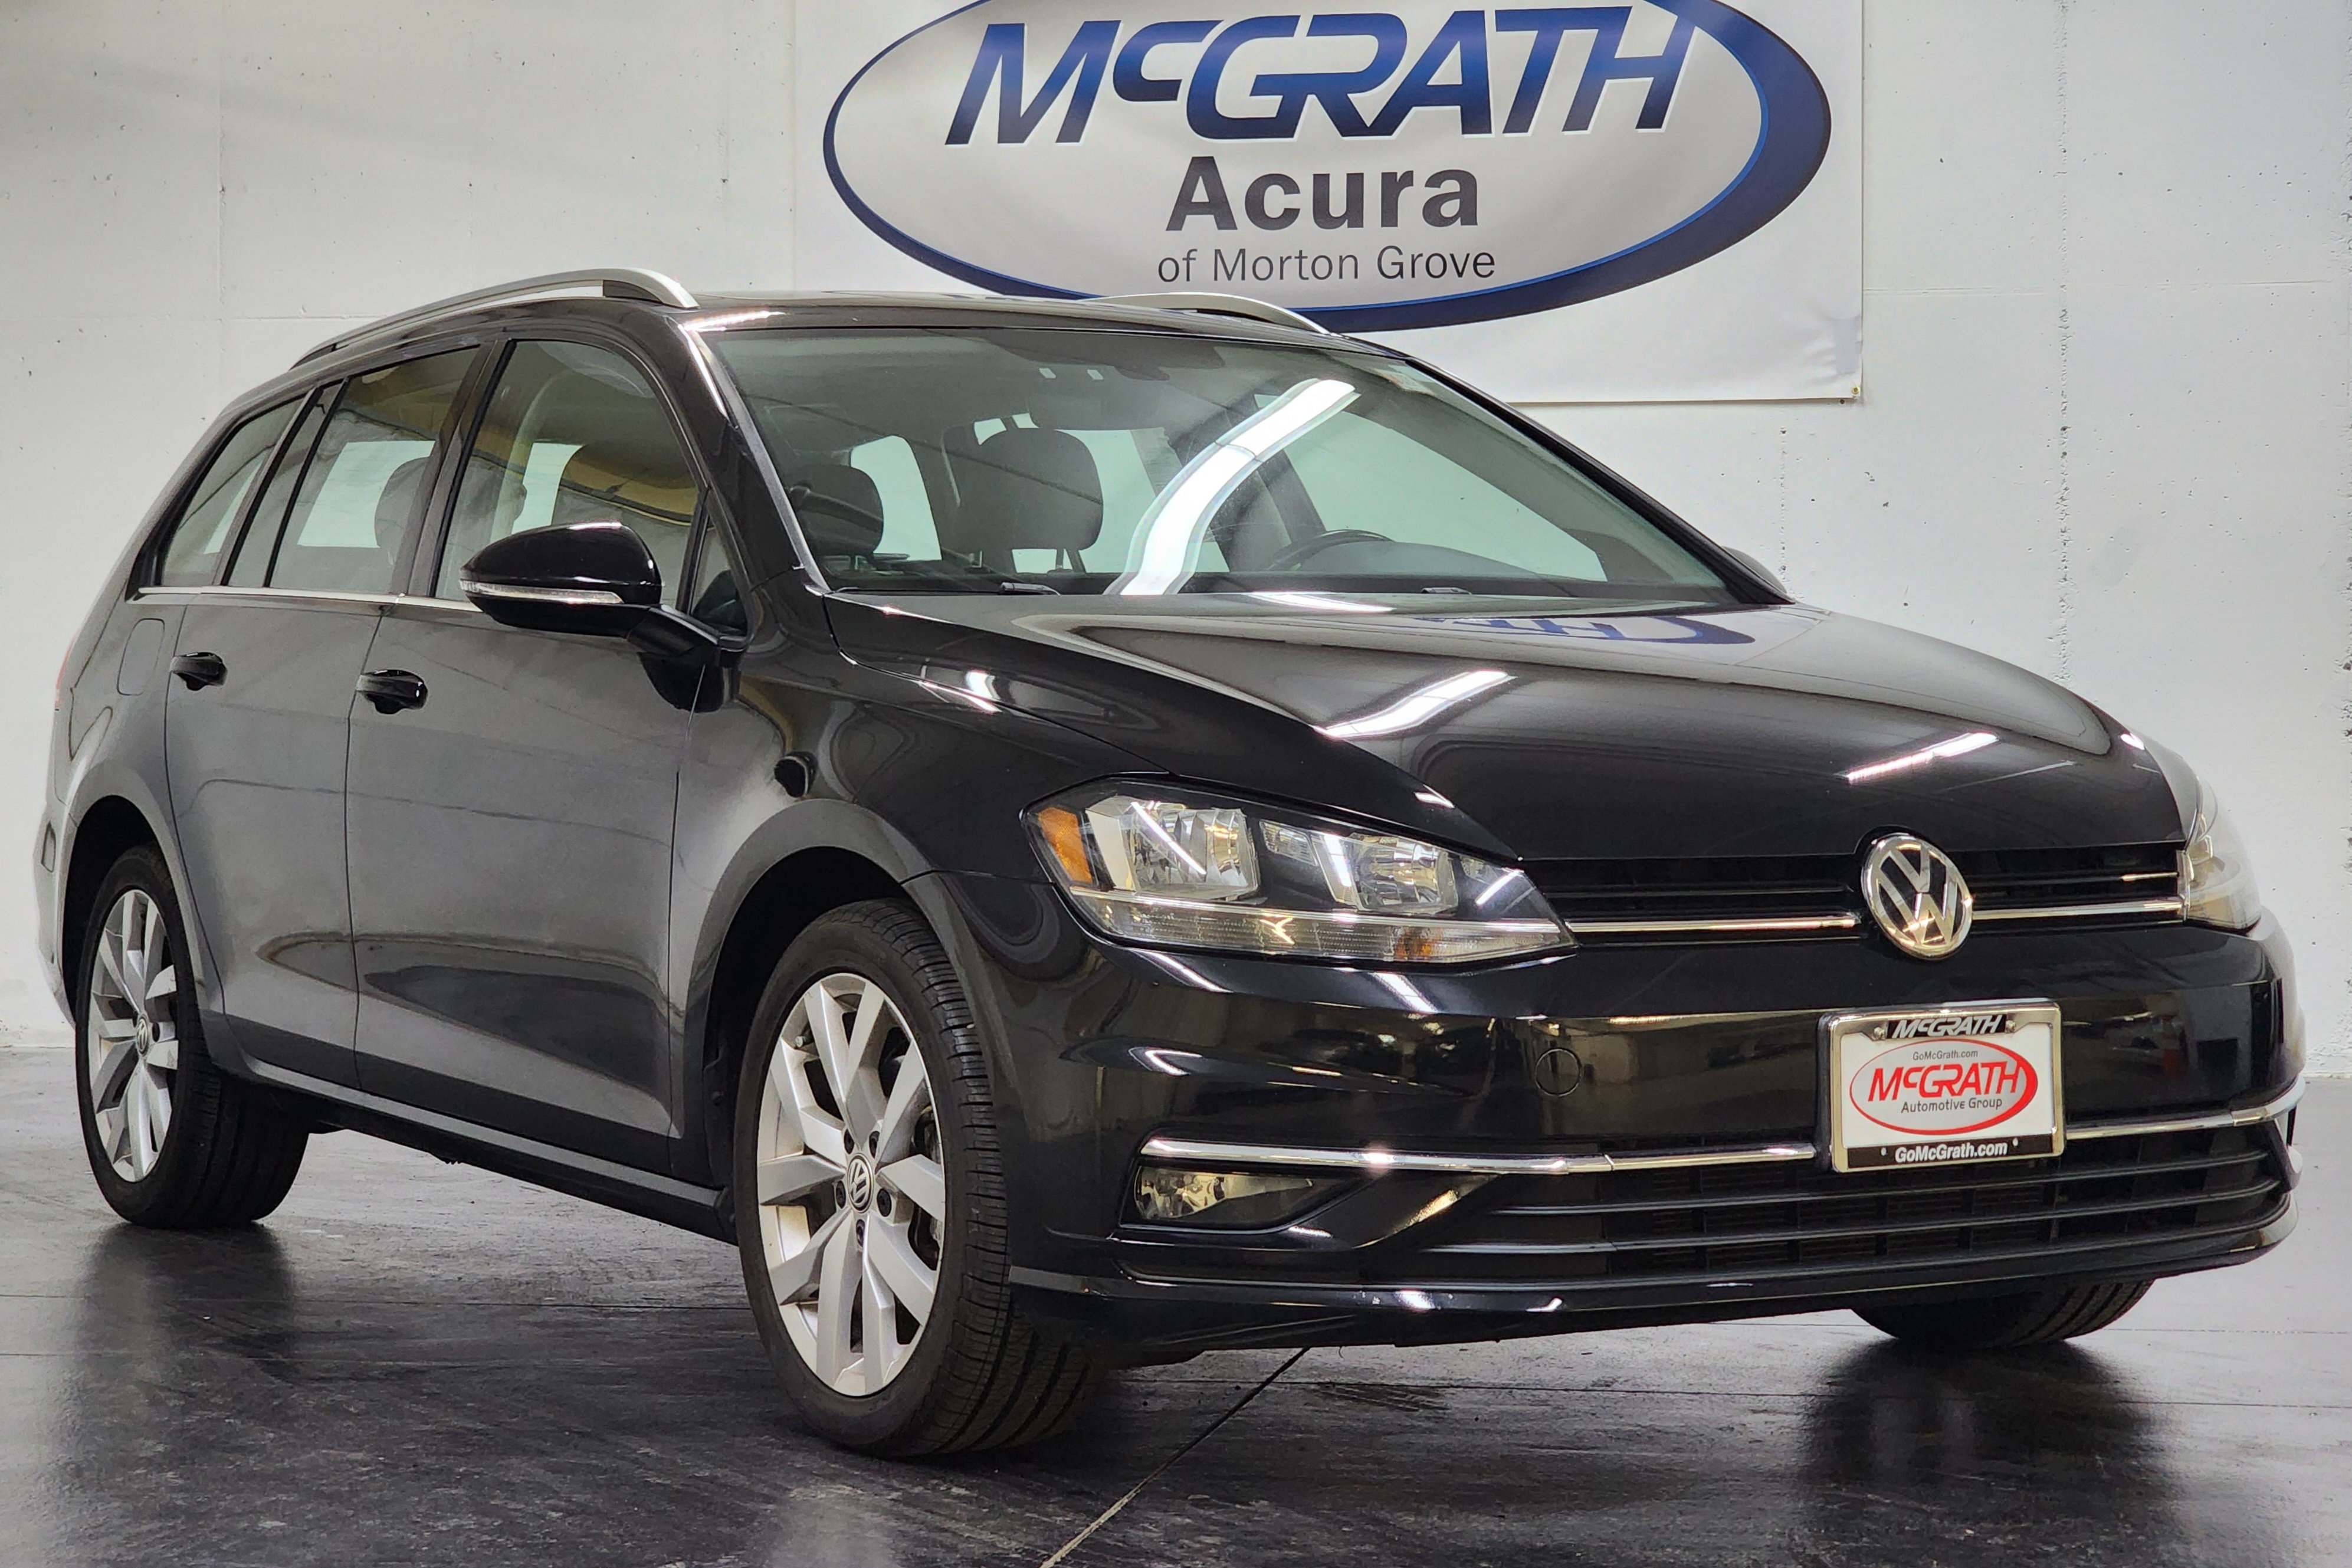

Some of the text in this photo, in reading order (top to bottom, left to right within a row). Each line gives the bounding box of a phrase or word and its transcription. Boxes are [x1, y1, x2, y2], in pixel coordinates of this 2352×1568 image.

[1166, 156, 1478, 232] Acura
[1157, 246, 1495, 282] of Morton Grove
[1913, 1050, 1978, 1061] GoMcGrath.com
[1901, 1097, 2002, 1113] Automotive Group
[1895, 1142, 2007, 1163] GoMcGrath.com
